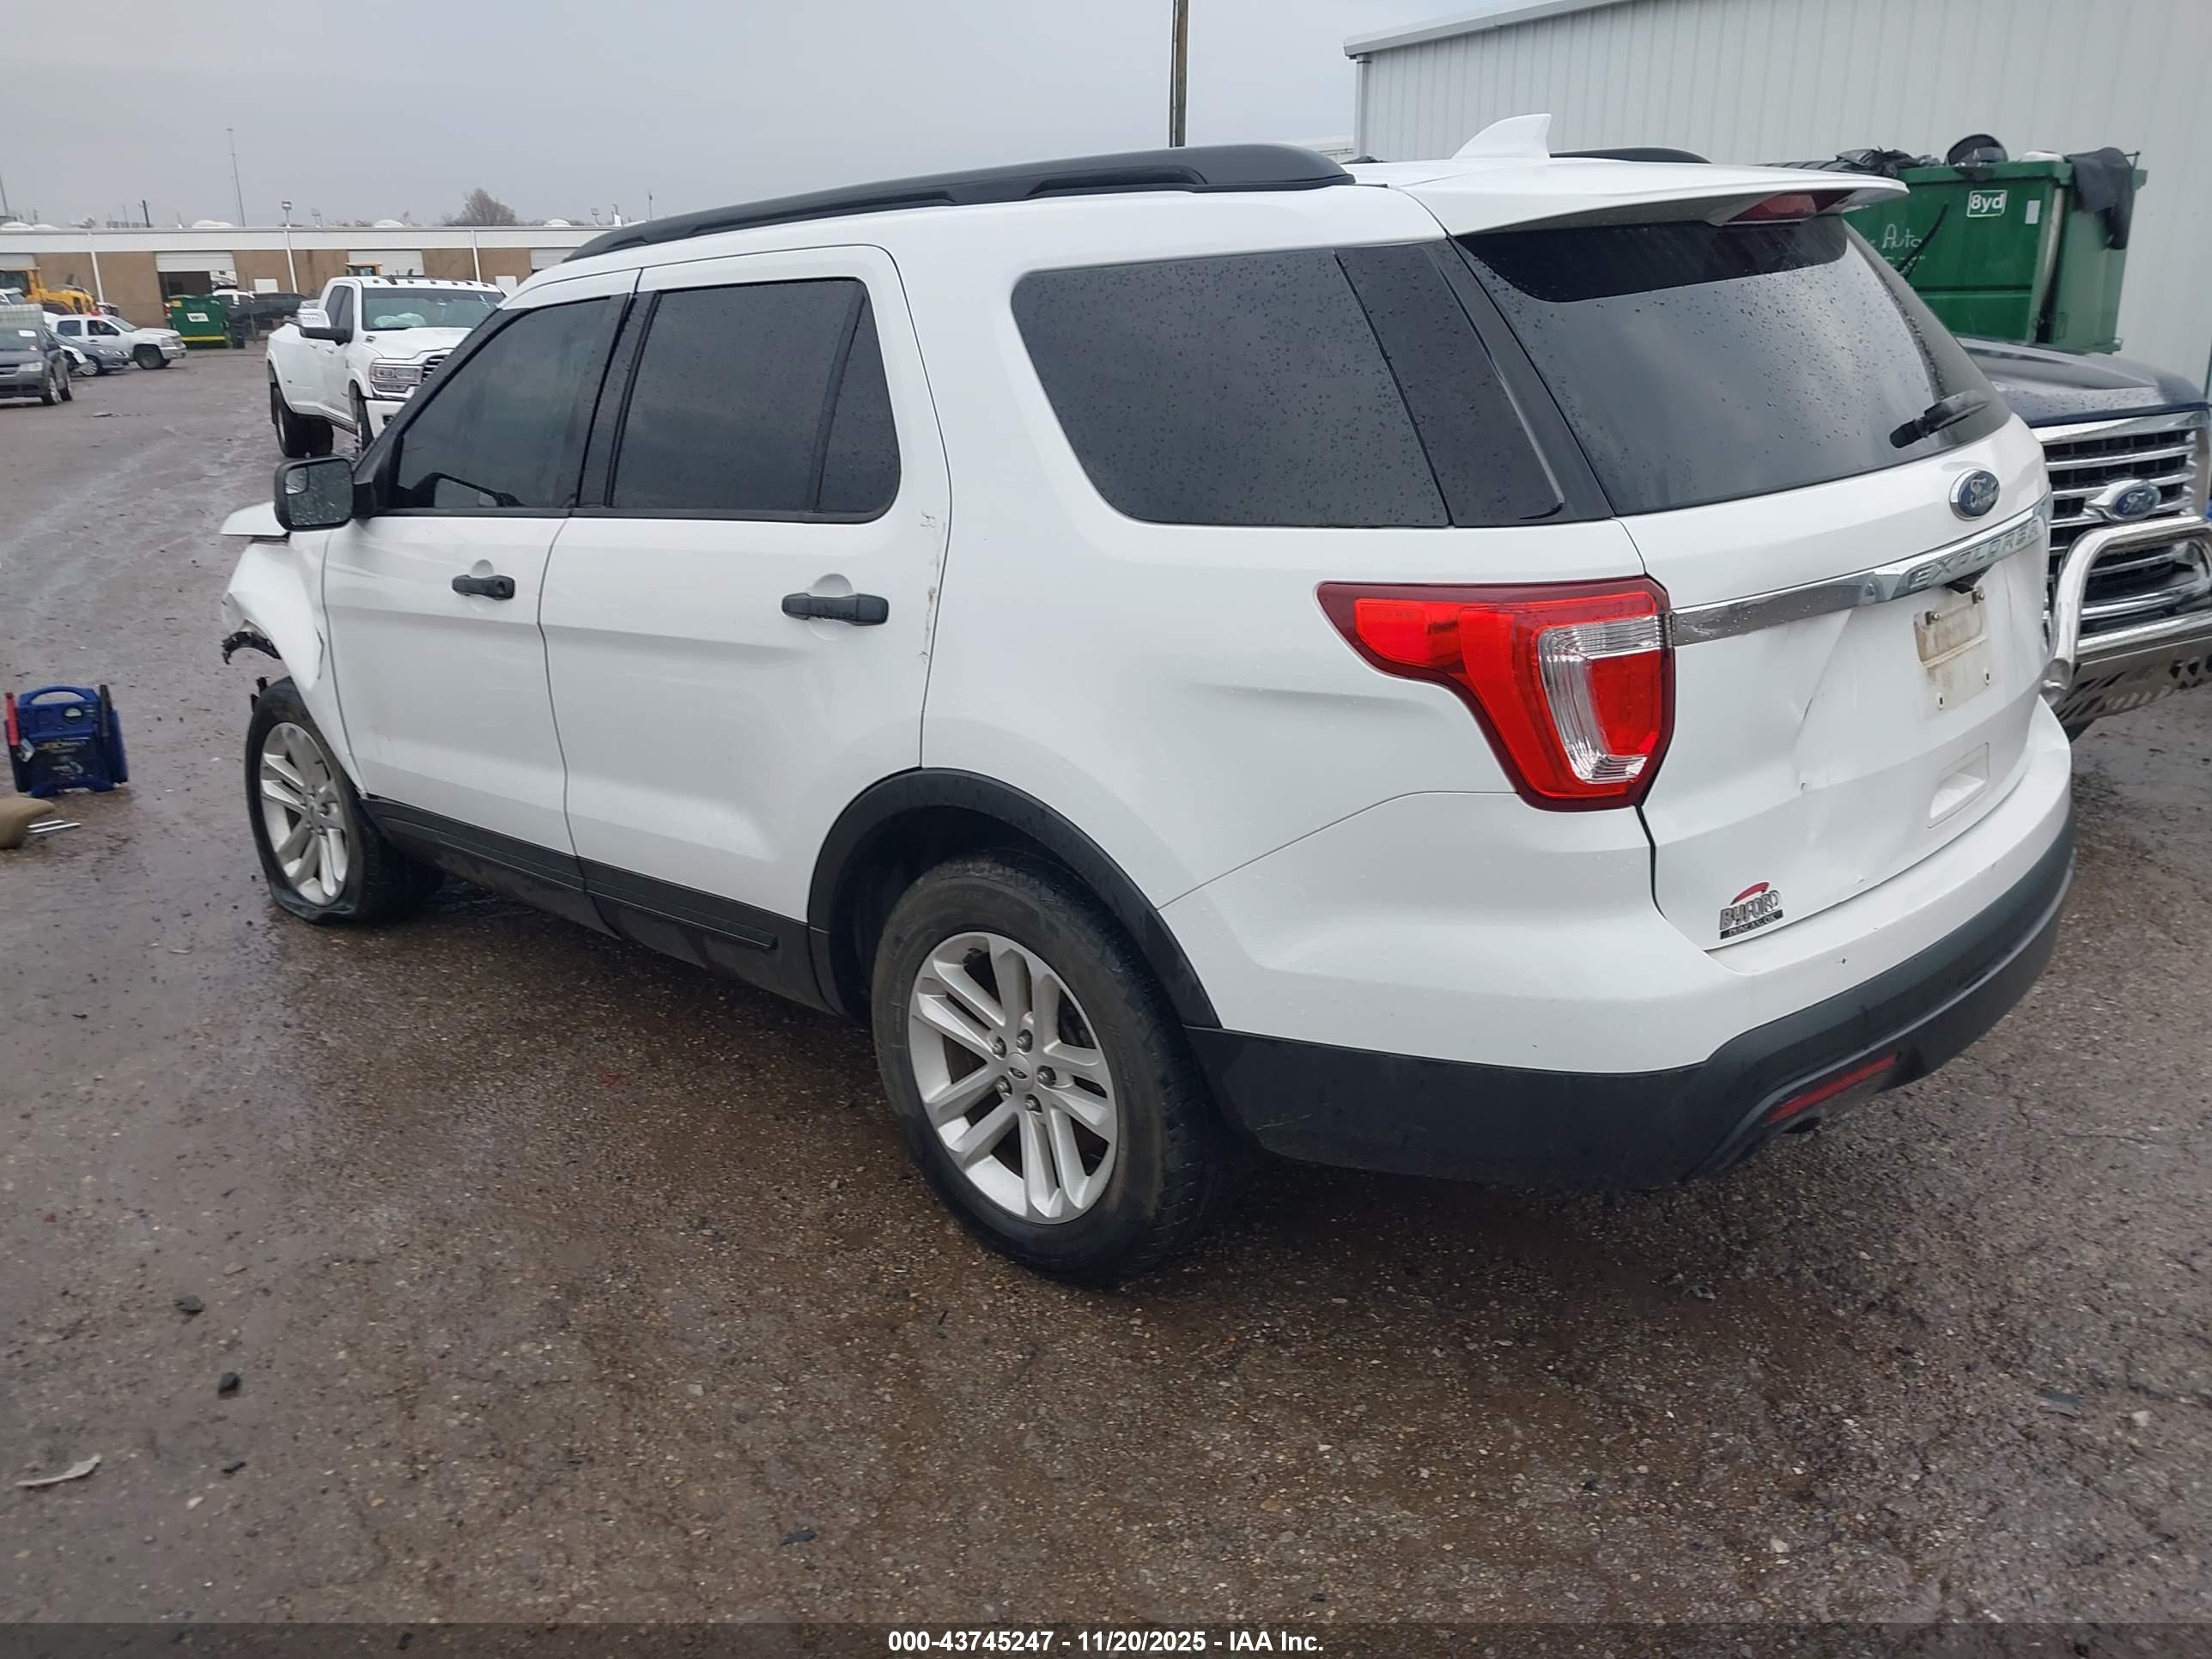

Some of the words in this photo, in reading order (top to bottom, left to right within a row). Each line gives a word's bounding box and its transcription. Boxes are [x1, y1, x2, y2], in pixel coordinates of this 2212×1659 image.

[1970, 193, 2004, 214] 8yd
[1881, 223, 1923, 249] Auto
[1908, 518, 2040, 590] EXPLORER
[1719, 889, 1781, 931] BYFORD
